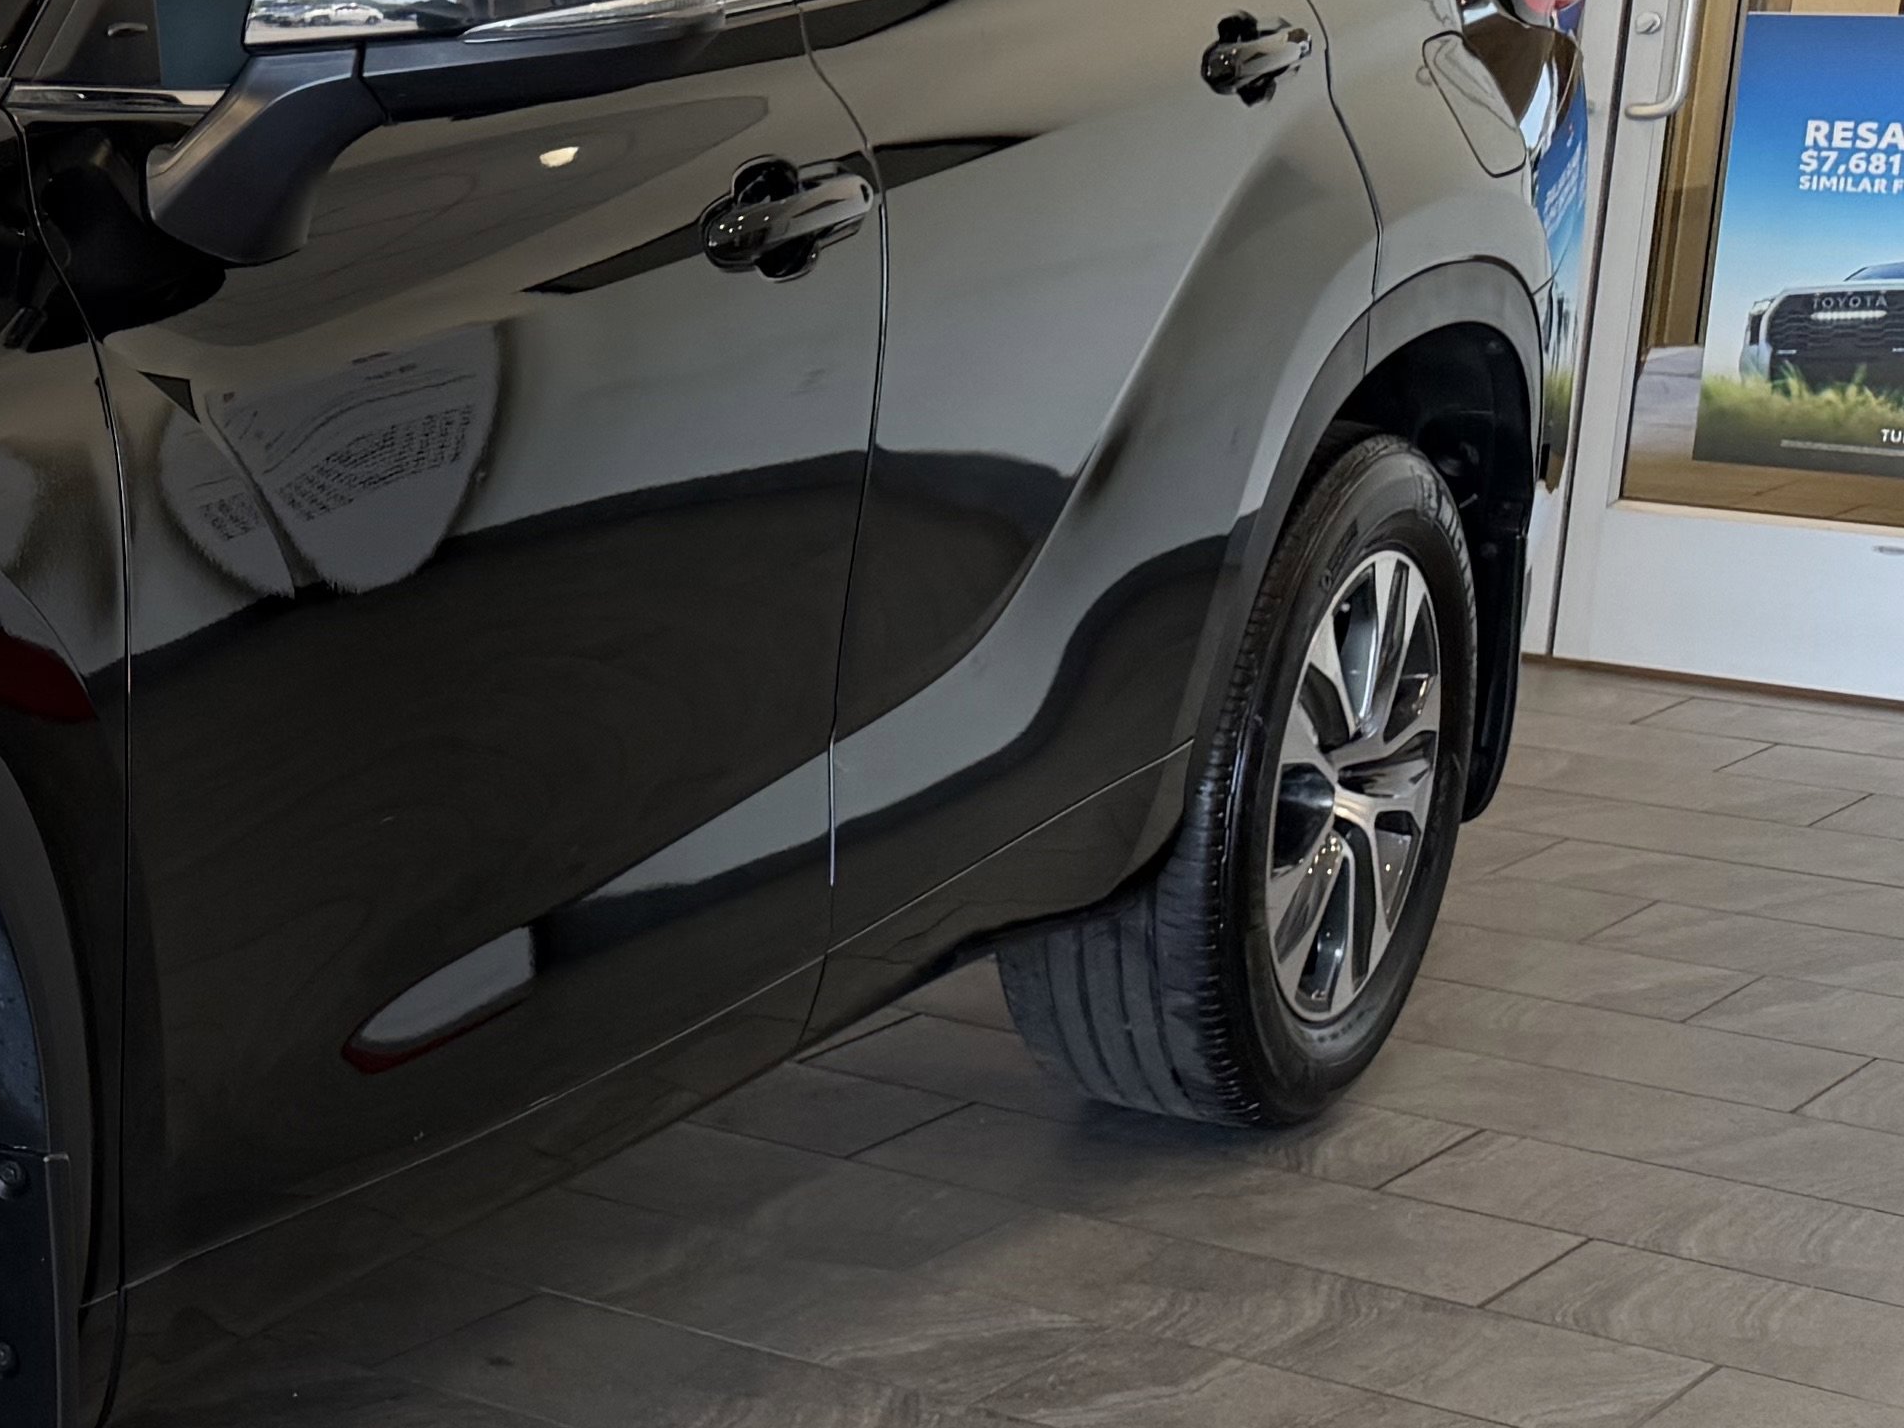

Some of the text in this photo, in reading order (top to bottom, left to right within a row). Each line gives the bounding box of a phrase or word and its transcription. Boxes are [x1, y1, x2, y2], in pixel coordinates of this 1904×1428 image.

[1799, 148, 1902, 177] $7,681
[1799, 174, 1887, 194] SIMILAR
[1812, 295, 1889, 311] TOYOTA
[1881, 428, 1904, 444] TU
